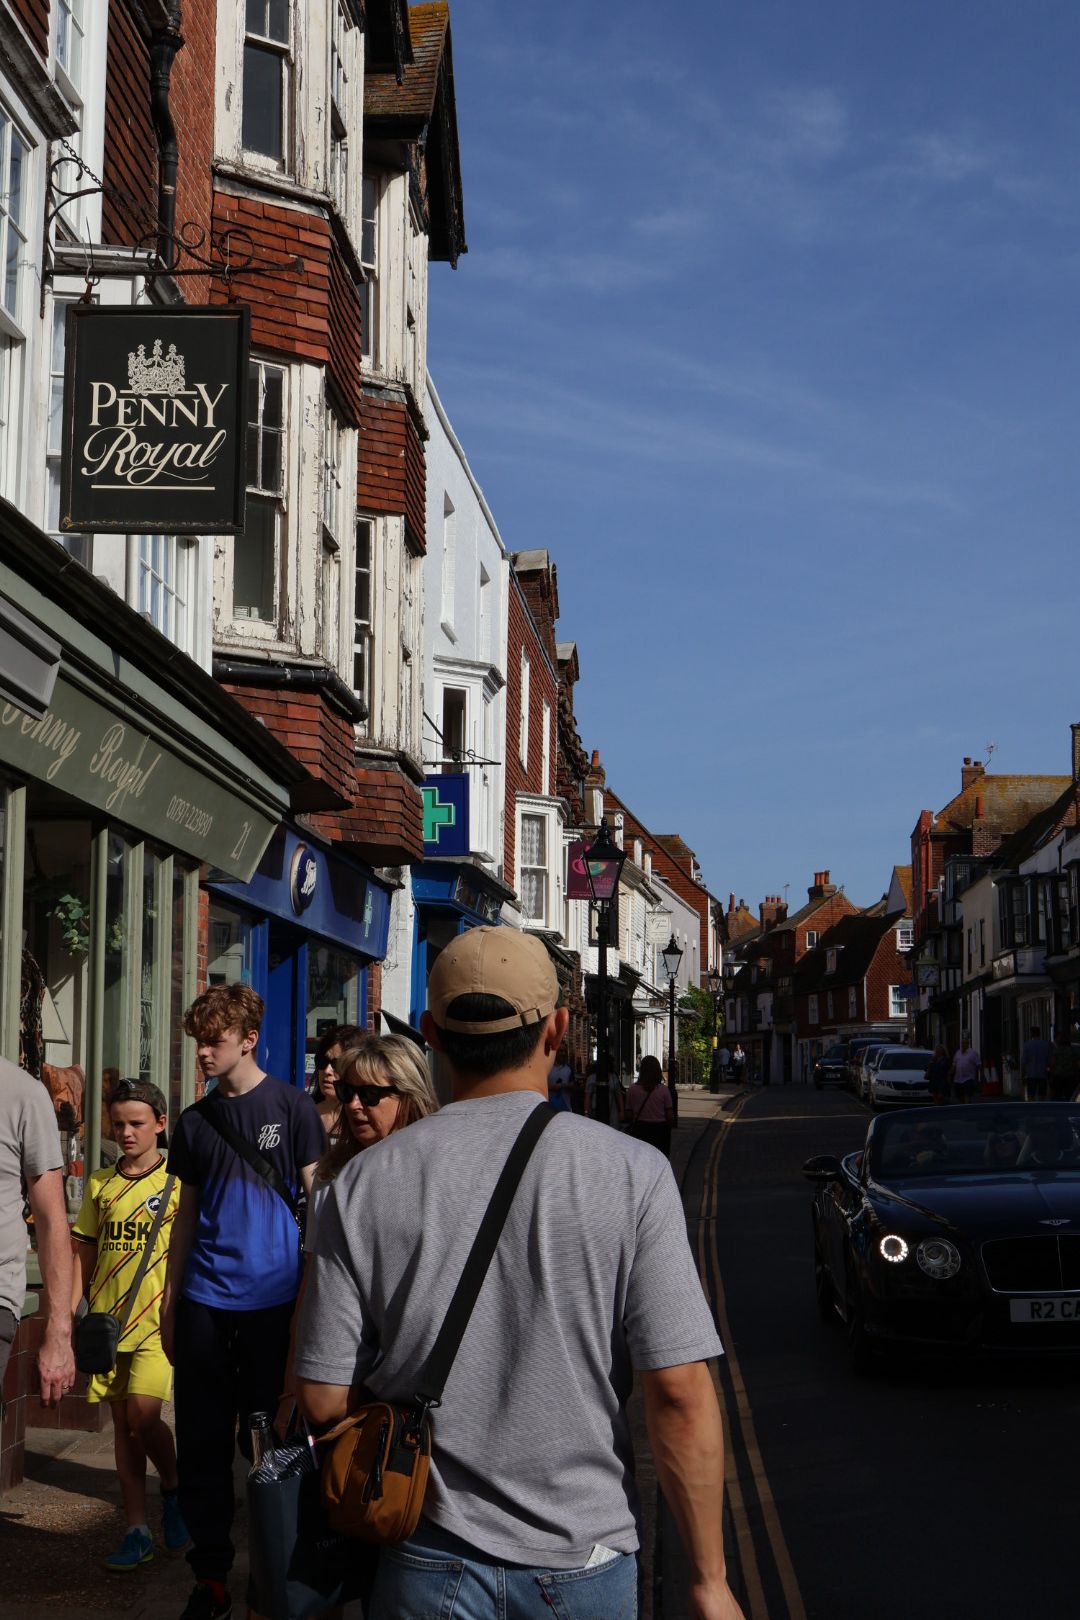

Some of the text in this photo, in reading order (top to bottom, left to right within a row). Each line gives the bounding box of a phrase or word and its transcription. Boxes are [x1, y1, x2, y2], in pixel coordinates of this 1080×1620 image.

[89, 381, 230, 428] PENNY
[81, 426, 227, 485] Royal
[90, 723, 162, 809] Royal
[230, 821, 252, 861] 21
[102, 1242, 156, 1252] COCOLA
[1030, 1301, 1055, 1319] R2
